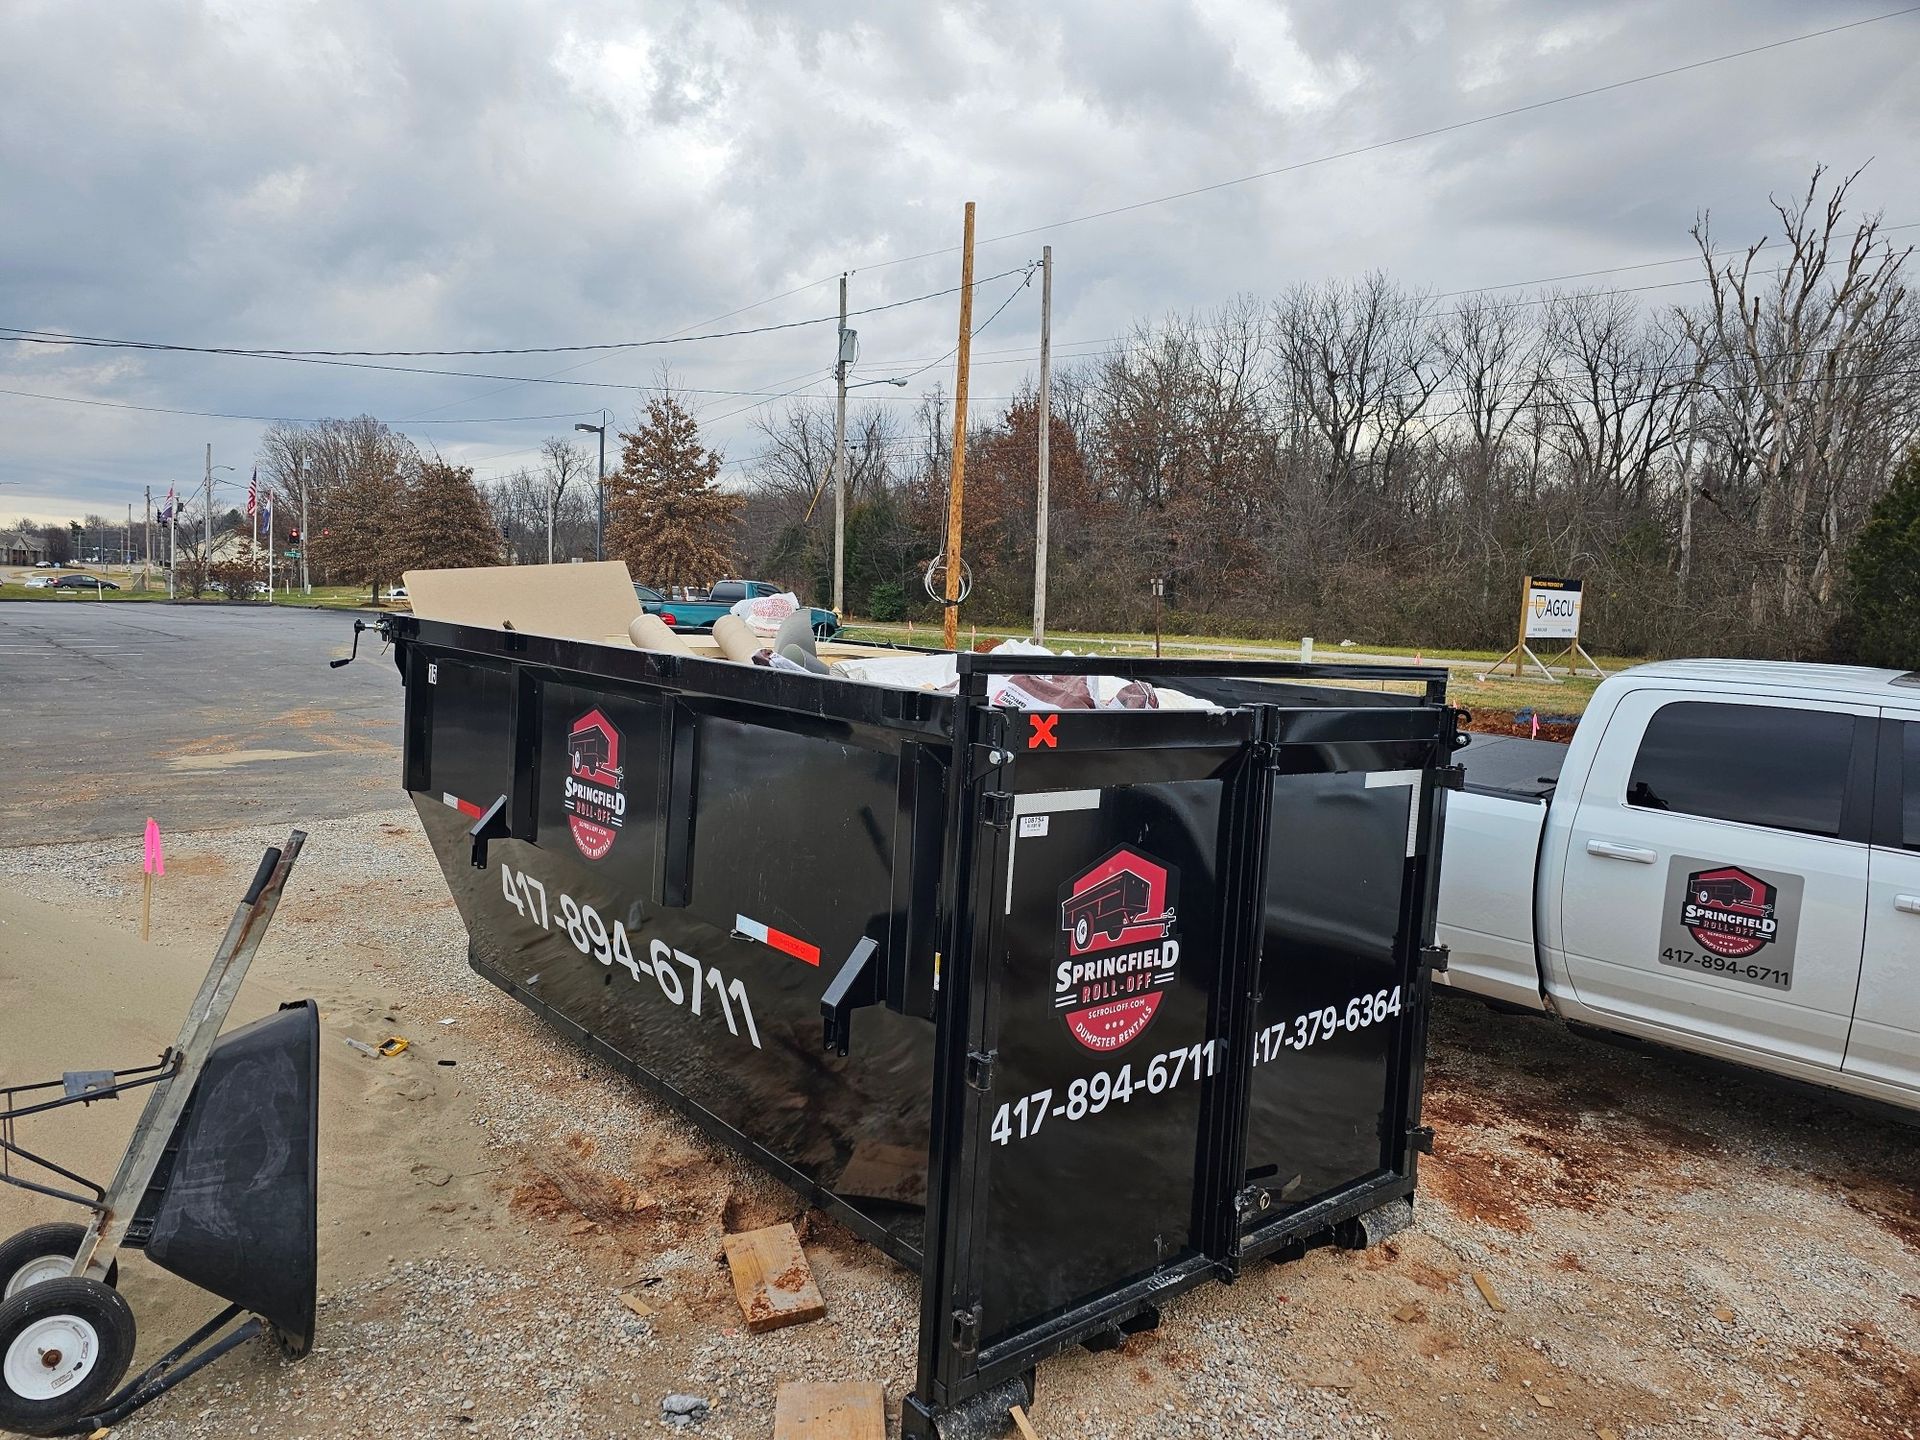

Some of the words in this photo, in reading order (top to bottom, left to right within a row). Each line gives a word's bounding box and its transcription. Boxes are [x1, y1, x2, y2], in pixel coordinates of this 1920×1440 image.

[1545, 599, 1575, 617] AGCU
[565, 776, 626, 816] SPRINGFIELD
[576, 800, 612, 824] ROLL-OFF
[1684, 905, 1776, 933] SPRINGFIELD
[1703, 920, 1754, 937] ROLL-OFF
[502, 863, 762, 1049] 417-894-6711
[1698, 933, 1727, 953] DUMPSTER
[1728, 943, 1754, 954] RENTALS
[1056, 940, 1180, 992] SPRINGFIELD
[1662, 948, 1789, 986] 417-894-6711
[1082, 972, 1152, 1004] ROLL-OFF
[1088, 998, 1145, 1019] SGFROLLOFF.COM
[1075, 1022, 1116, 1047] DUMPSTER
[1118, 1006, 1152, 1043] RENTALS
[991, 1039, 1215, 1146] 417-894-6711
